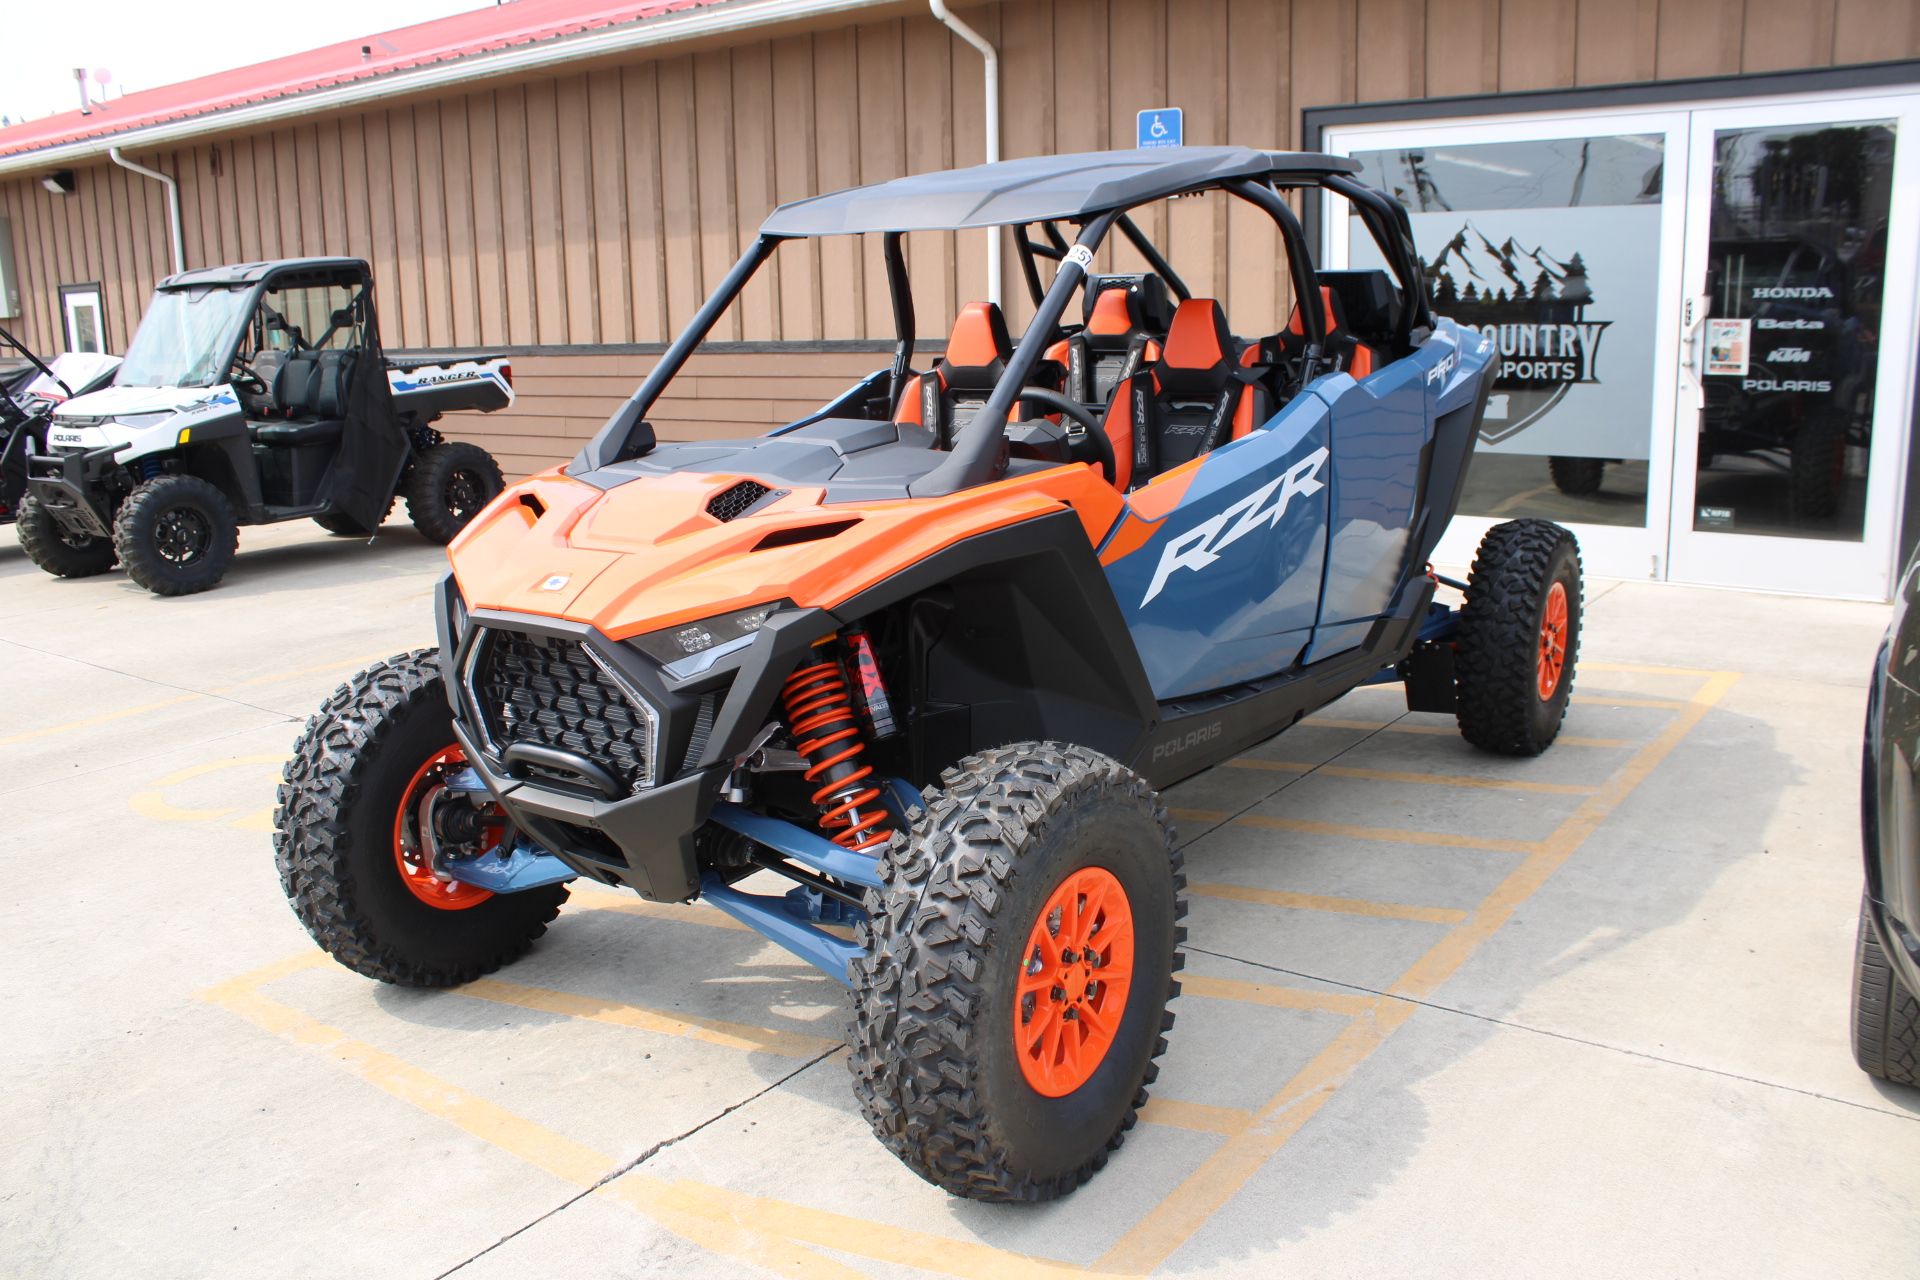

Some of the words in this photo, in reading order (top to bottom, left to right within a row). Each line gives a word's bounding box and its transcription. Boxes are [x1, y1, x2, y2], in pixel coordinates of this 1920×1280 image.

[1752, 287, 1834, 298] HONDA
[1757, 318, 1824, 329] Beta
[1467, 323, 1603, 381] OUNTRY
[1766, 348, 1811, 362] KTM
[1427, 353, 1454, 386] PRO
[418, 371, 475, 385] RANGER
[1742, 379, 1832, 392] POLARIS
[1135, 389, 1146, 425] RZR
[53, 434, 82, 443] POLARIS
[1139, 446, 1330, 610] RZR
[1152, 721, 1222, 763] POLARIS
